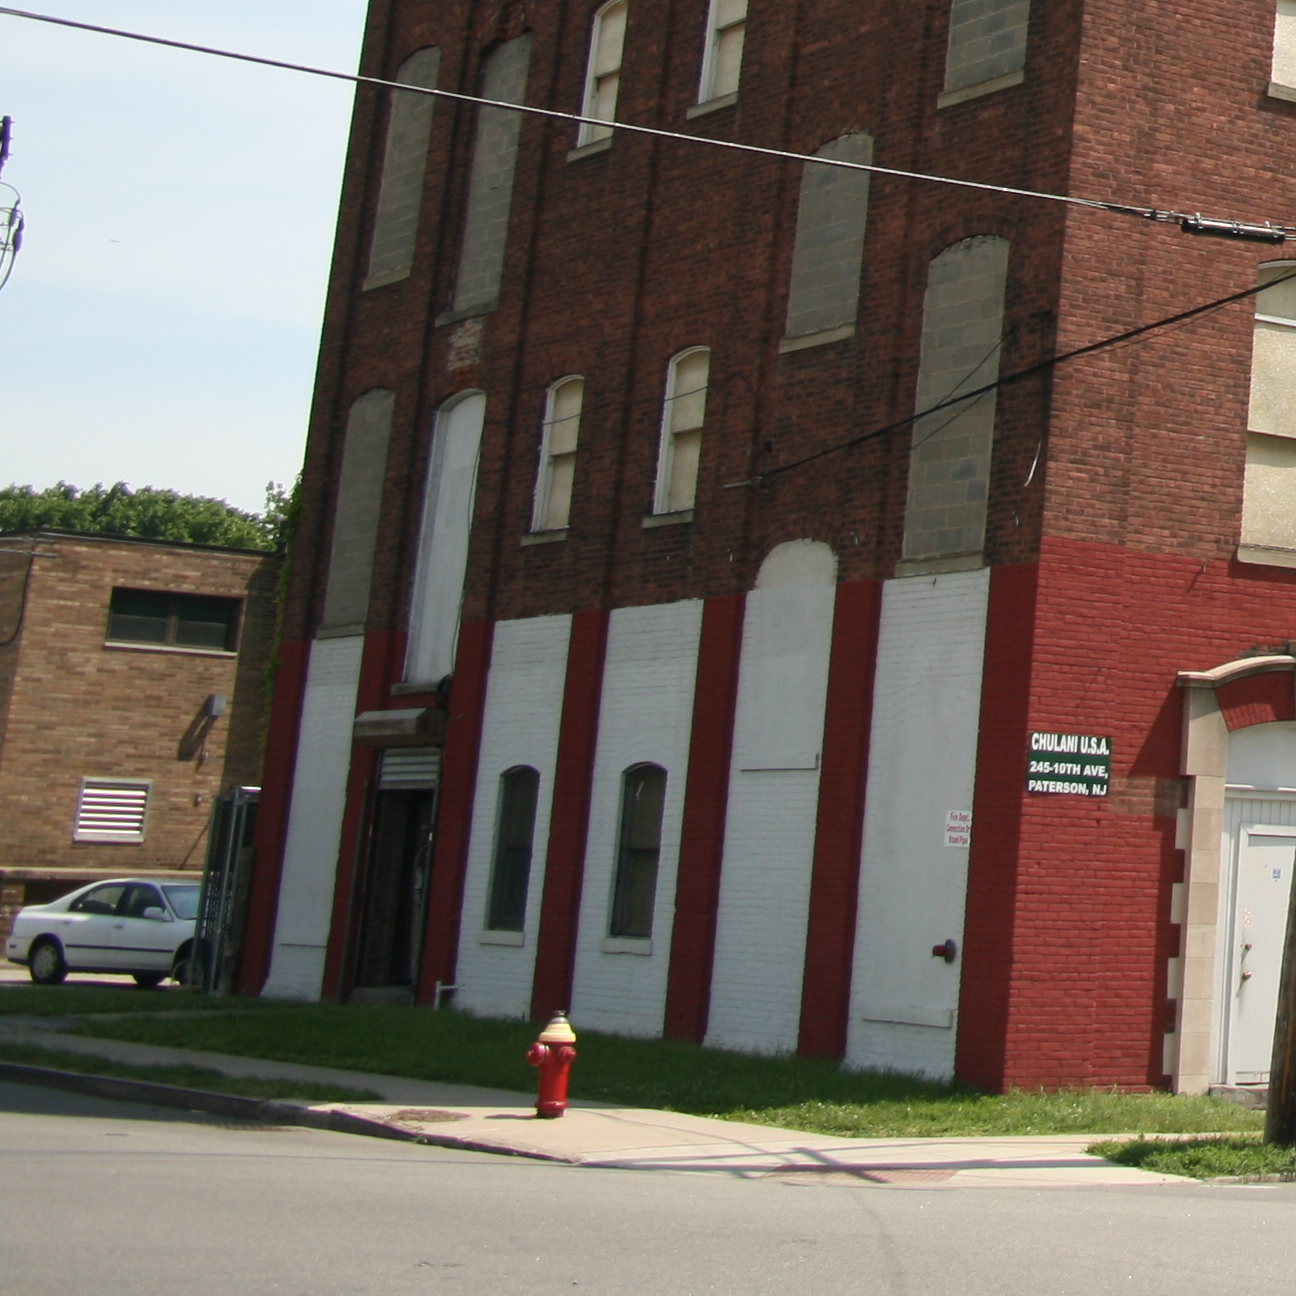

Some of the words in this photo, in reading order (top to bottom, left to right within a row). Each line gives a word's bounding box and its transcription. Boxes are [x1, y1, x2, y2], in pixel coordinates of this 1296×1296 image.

[1031, 732, 1078, 753] CHULANI
[1080, 736, 1110, 755] U.S.A.
[1029, 761, 1081, 776] 245-10TH
[1083, 765, 1108, 779] AVE,
[1028, 779, 1089, 796] PATERSON,
[1092, 784, 1108, 796] NJ
